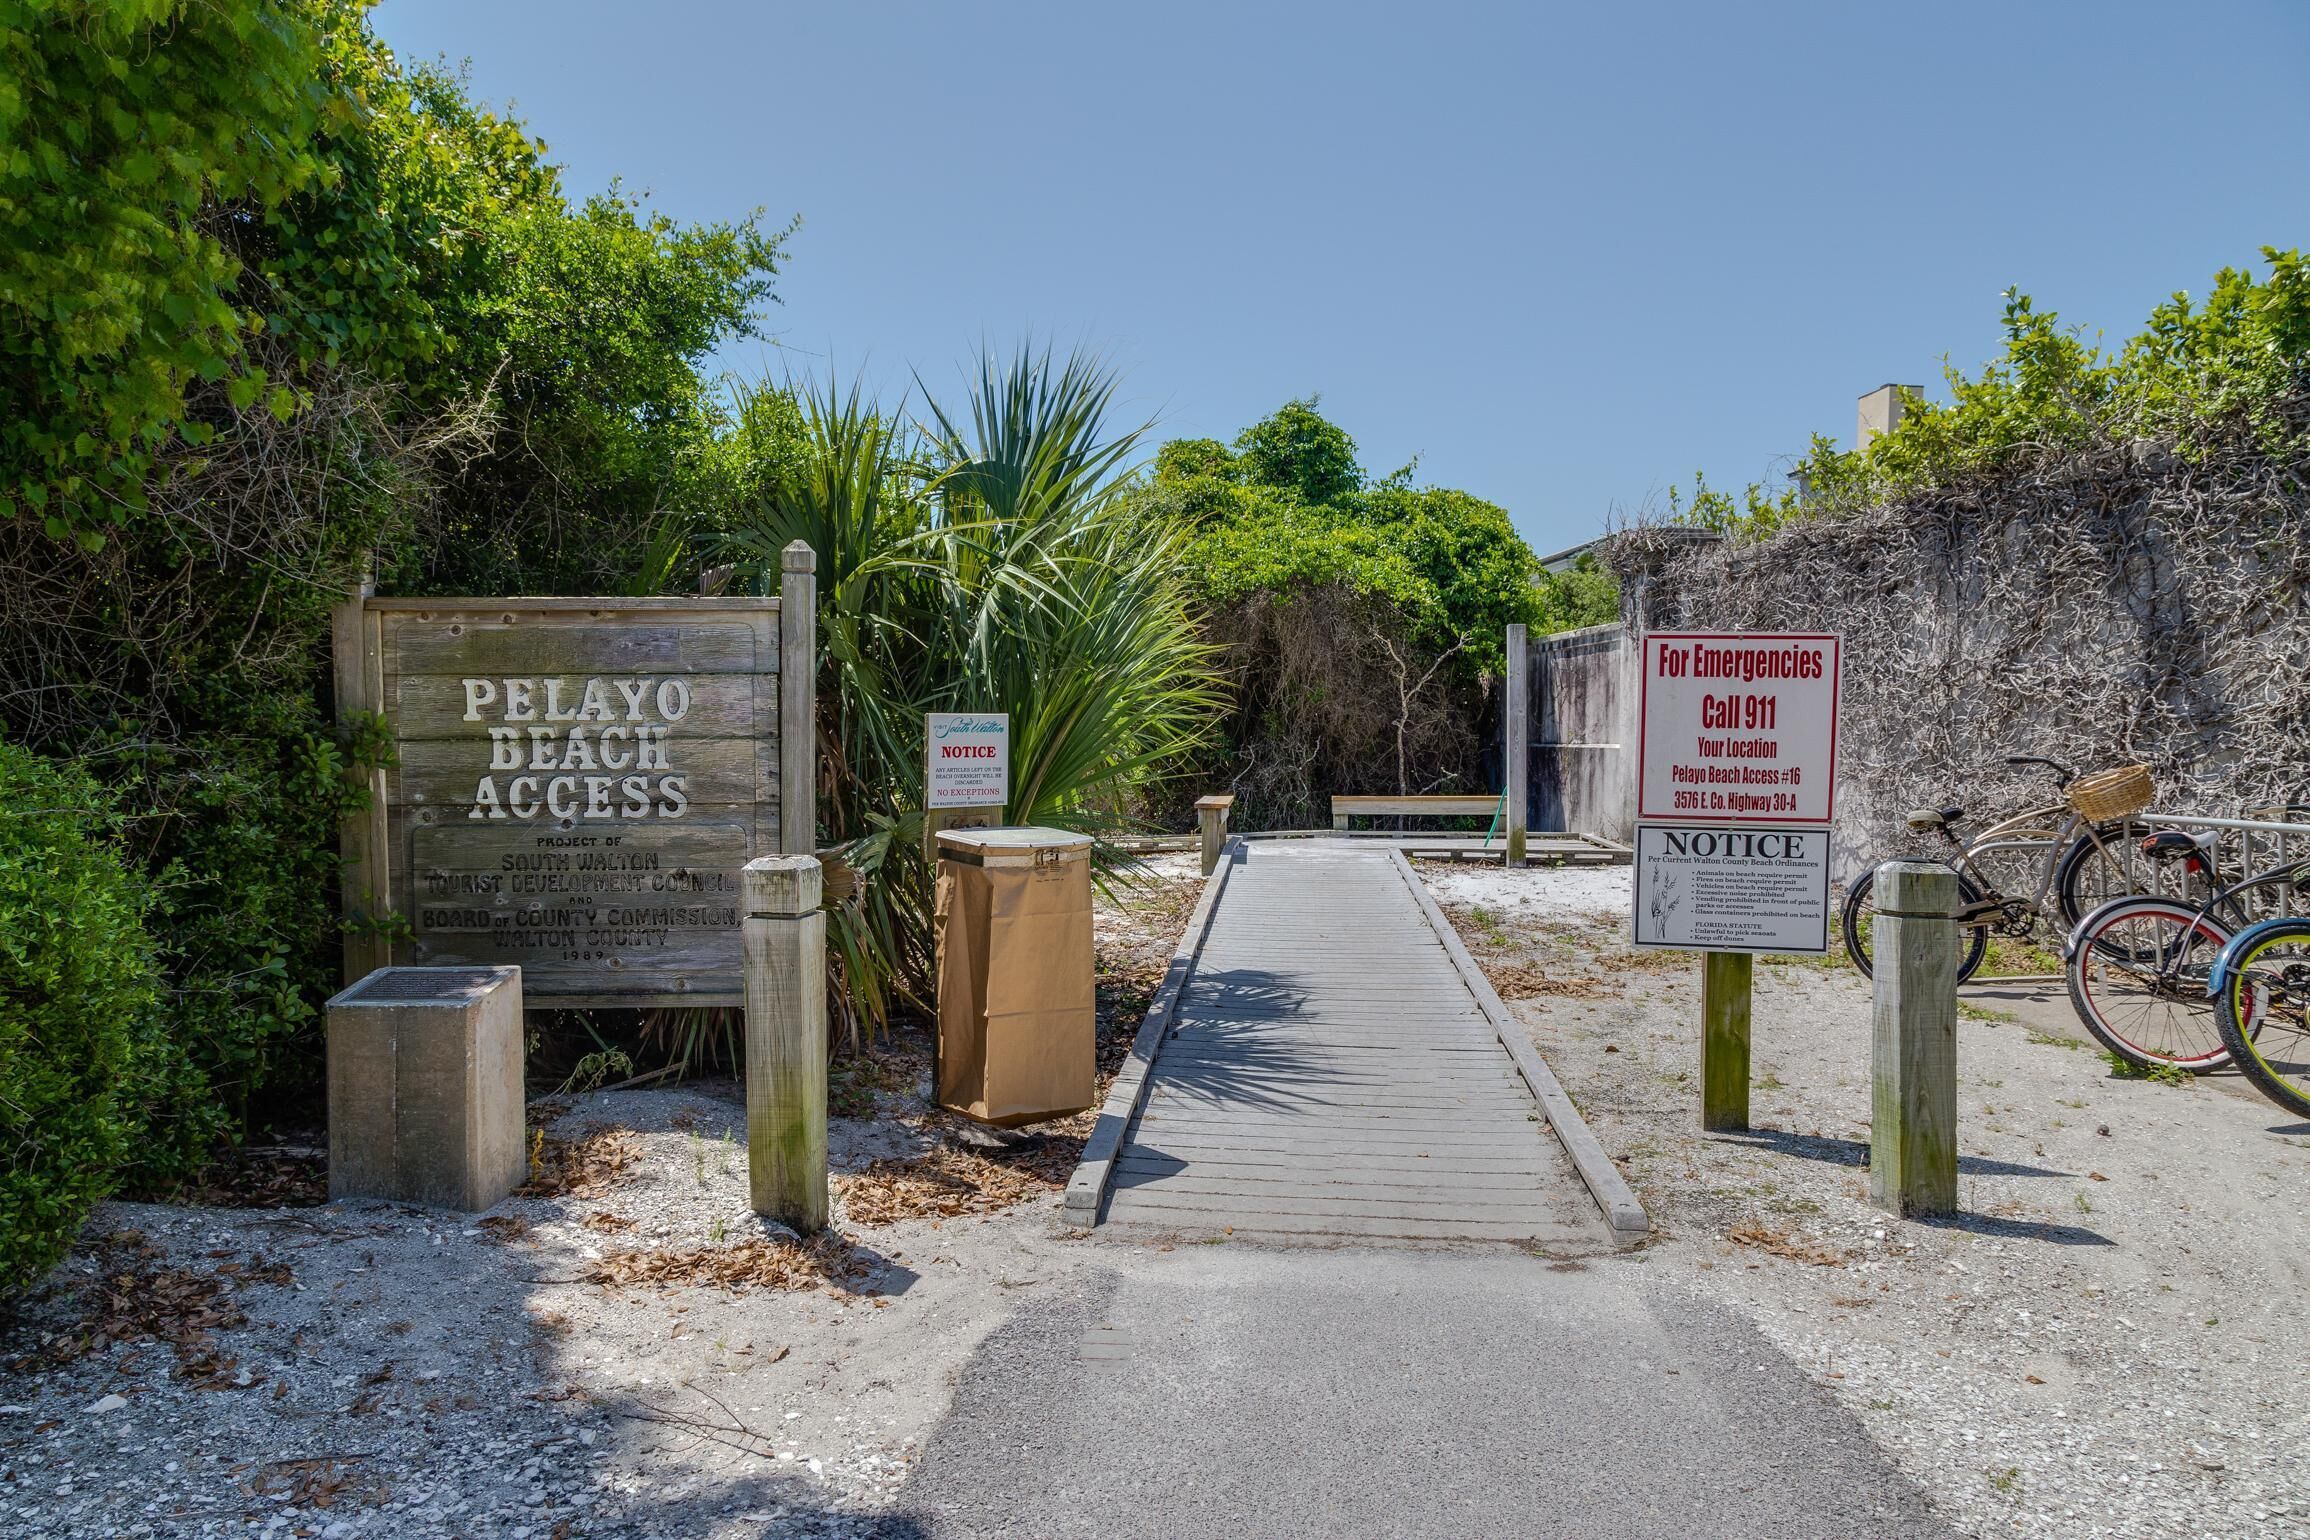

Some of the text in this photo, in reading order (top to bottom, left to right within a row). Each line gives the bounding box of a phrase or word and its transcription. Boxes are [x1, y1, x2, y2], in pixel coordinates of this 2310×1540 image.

[1659, 643, 1823, 682] For Emergencies
[462, 678, 691, 722] PELAYO
[1702, 694, 1776, 730] Call 911
[488, 725, 671, 771] BEACH
[941, 746, 996, 758] NOTICE
[1698, 737, 1777, 759] Your Location
[1672, 765, 1801, 785] Pelayo Beach Access #16
[467, 775, 689, 819] ACCESS
[937, 788, 1000, 797] NO EXCEPTIONS
[1674, 791, 1797, 812] 3576 E. Co. Highway 30-A
[537, 836, 623, 848] PROJECT OF
[1662, 831, 1805, 859] NOTICE
[501, 852, 659, 872] SOUTH WALTON
[1648, 855, 1819, 868] Per Current Walton County Beach Ordinances
[424, 874, 735, 894] TOURIST DEVELOPMENT COUNCIL
[569, 897, 593, 905] AND
[1749, 891, 1785, 899] prohibited
[423, 908, 742, 928] BOARD OF COUNTY COMMISSION,
[495, 928, 669, 948] WALTON COUNTY
[563, 951, 604, 961] 1989
